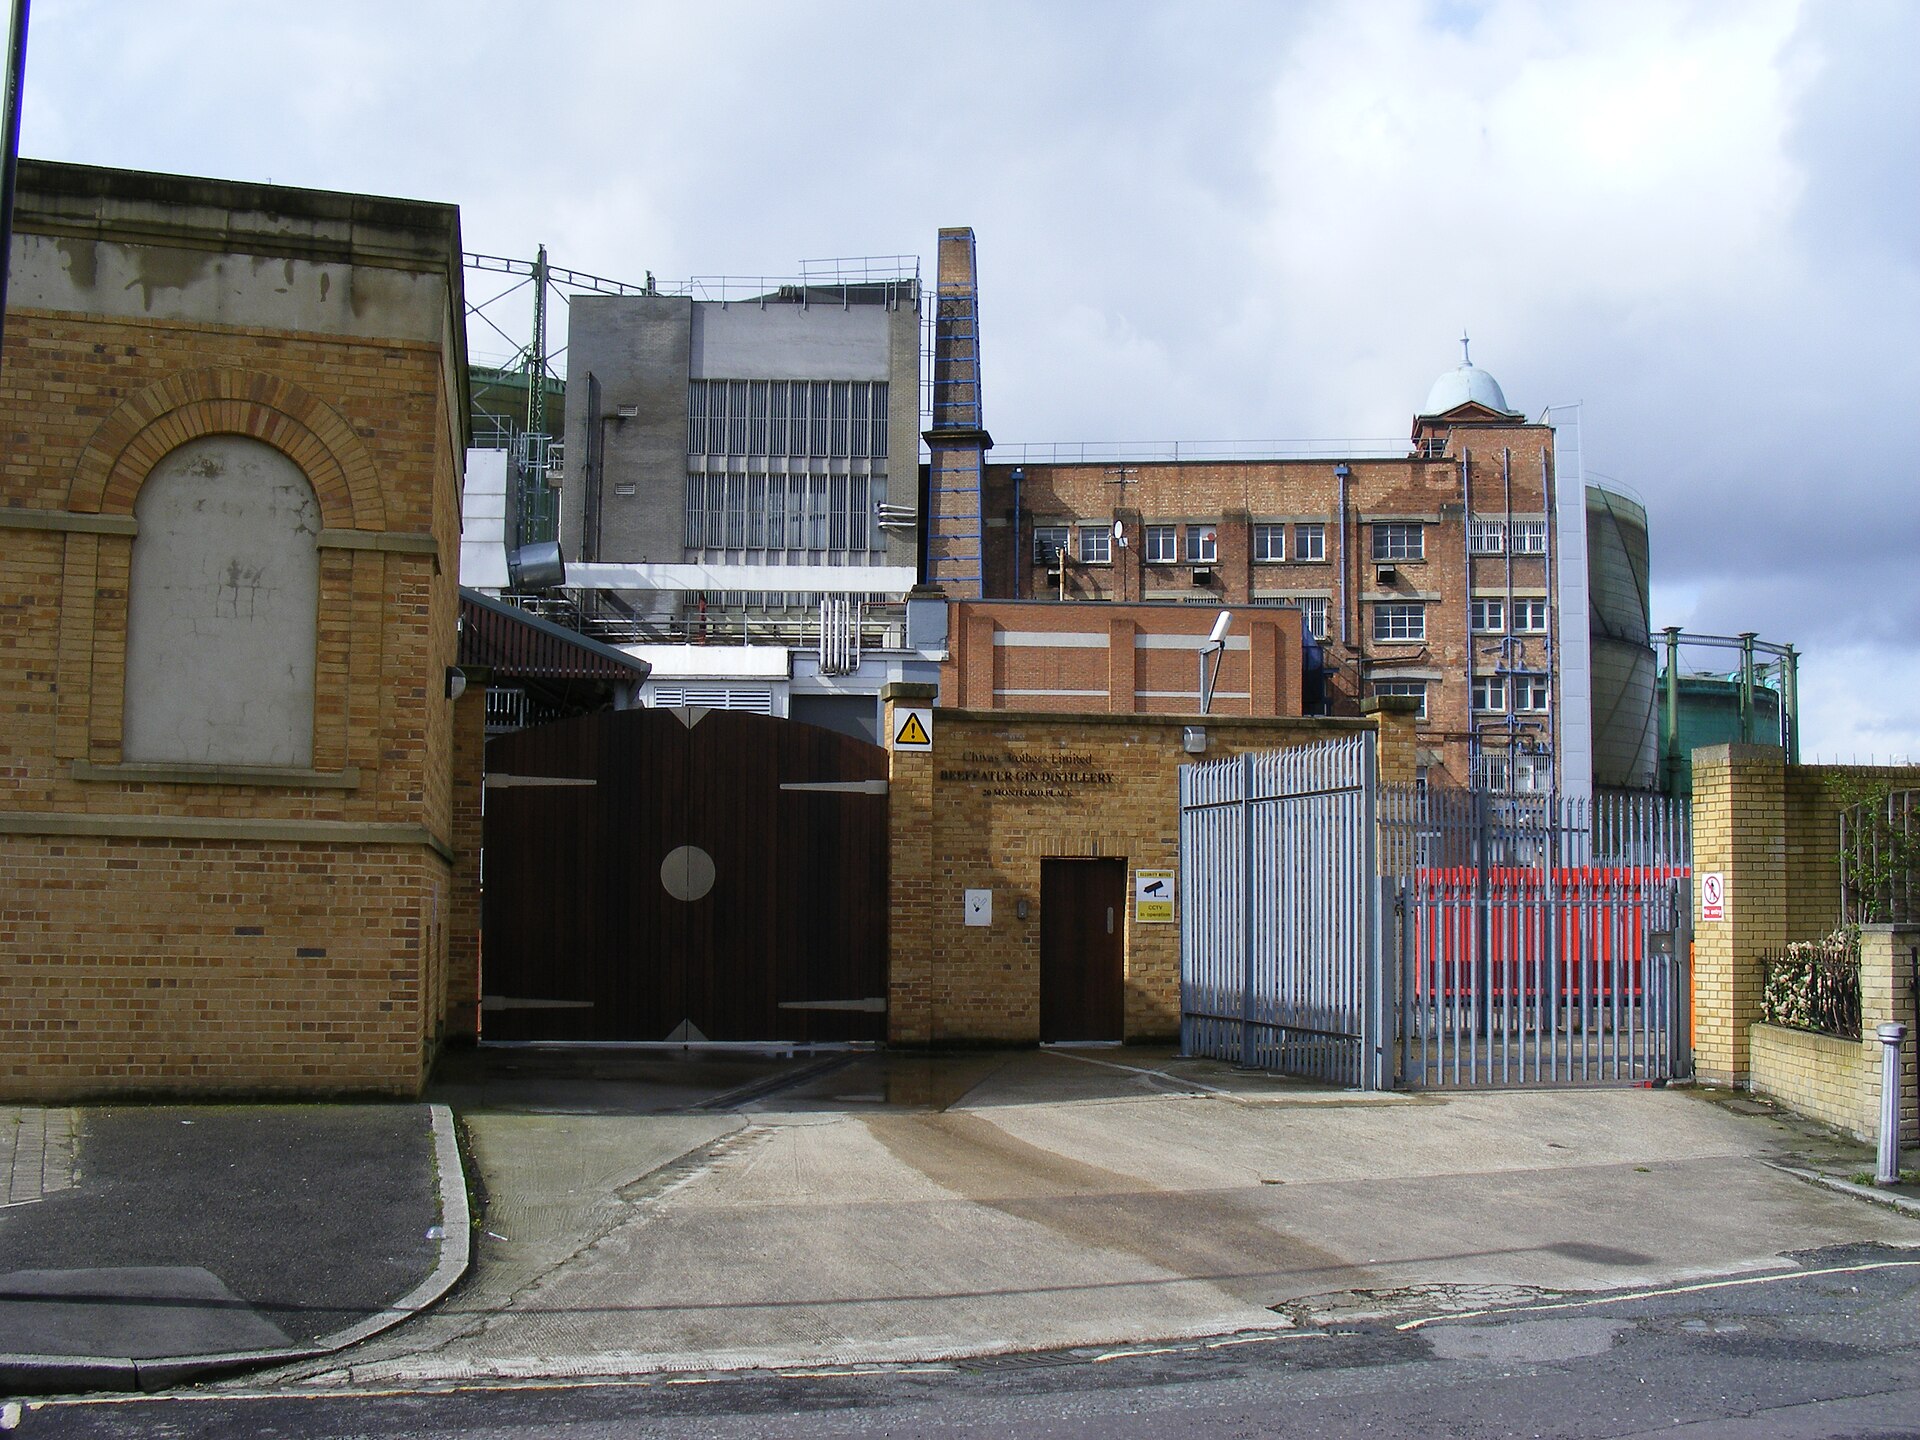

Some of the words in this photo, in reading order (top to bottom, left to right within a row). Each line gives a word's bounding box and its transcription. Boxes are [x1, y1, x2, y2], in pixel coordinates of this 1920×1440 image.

[1051, 753, 1092, 764] Limited
[1015, 771, 1038, 782] GIN
[1042, 771, 1114, 783] DISTILLERY
